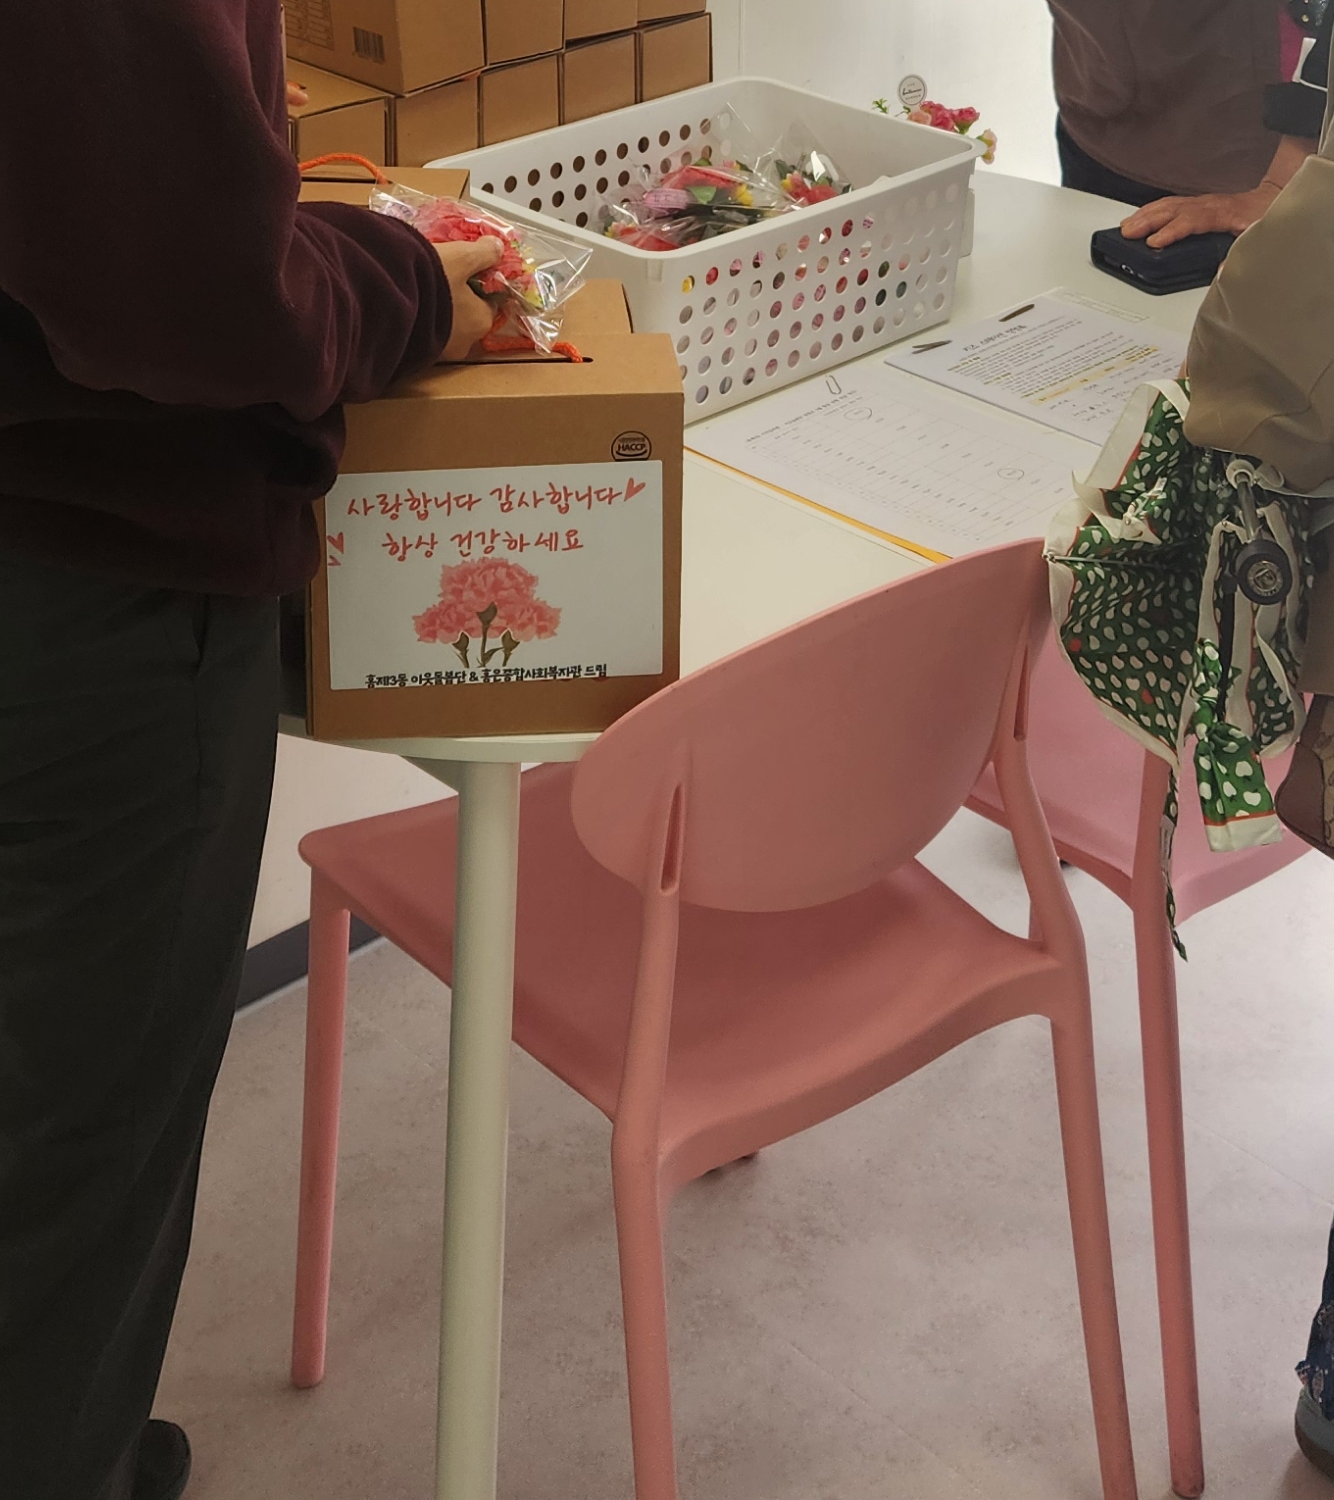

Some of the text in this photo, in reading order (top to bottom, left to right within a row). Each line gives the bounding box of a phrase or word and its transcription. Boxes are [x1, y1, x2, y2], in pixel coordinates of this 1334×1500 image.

[618, 443, 646, 452] HACCP
[347, 482, 624, 521] 사랑합니다 감사합니다
[382, 528, 584, 562] 항상 건강하세요
[365, 663, 608, 689] 홍제3동 이웃돌봄단 & 홍은종합사회복지관 드림
